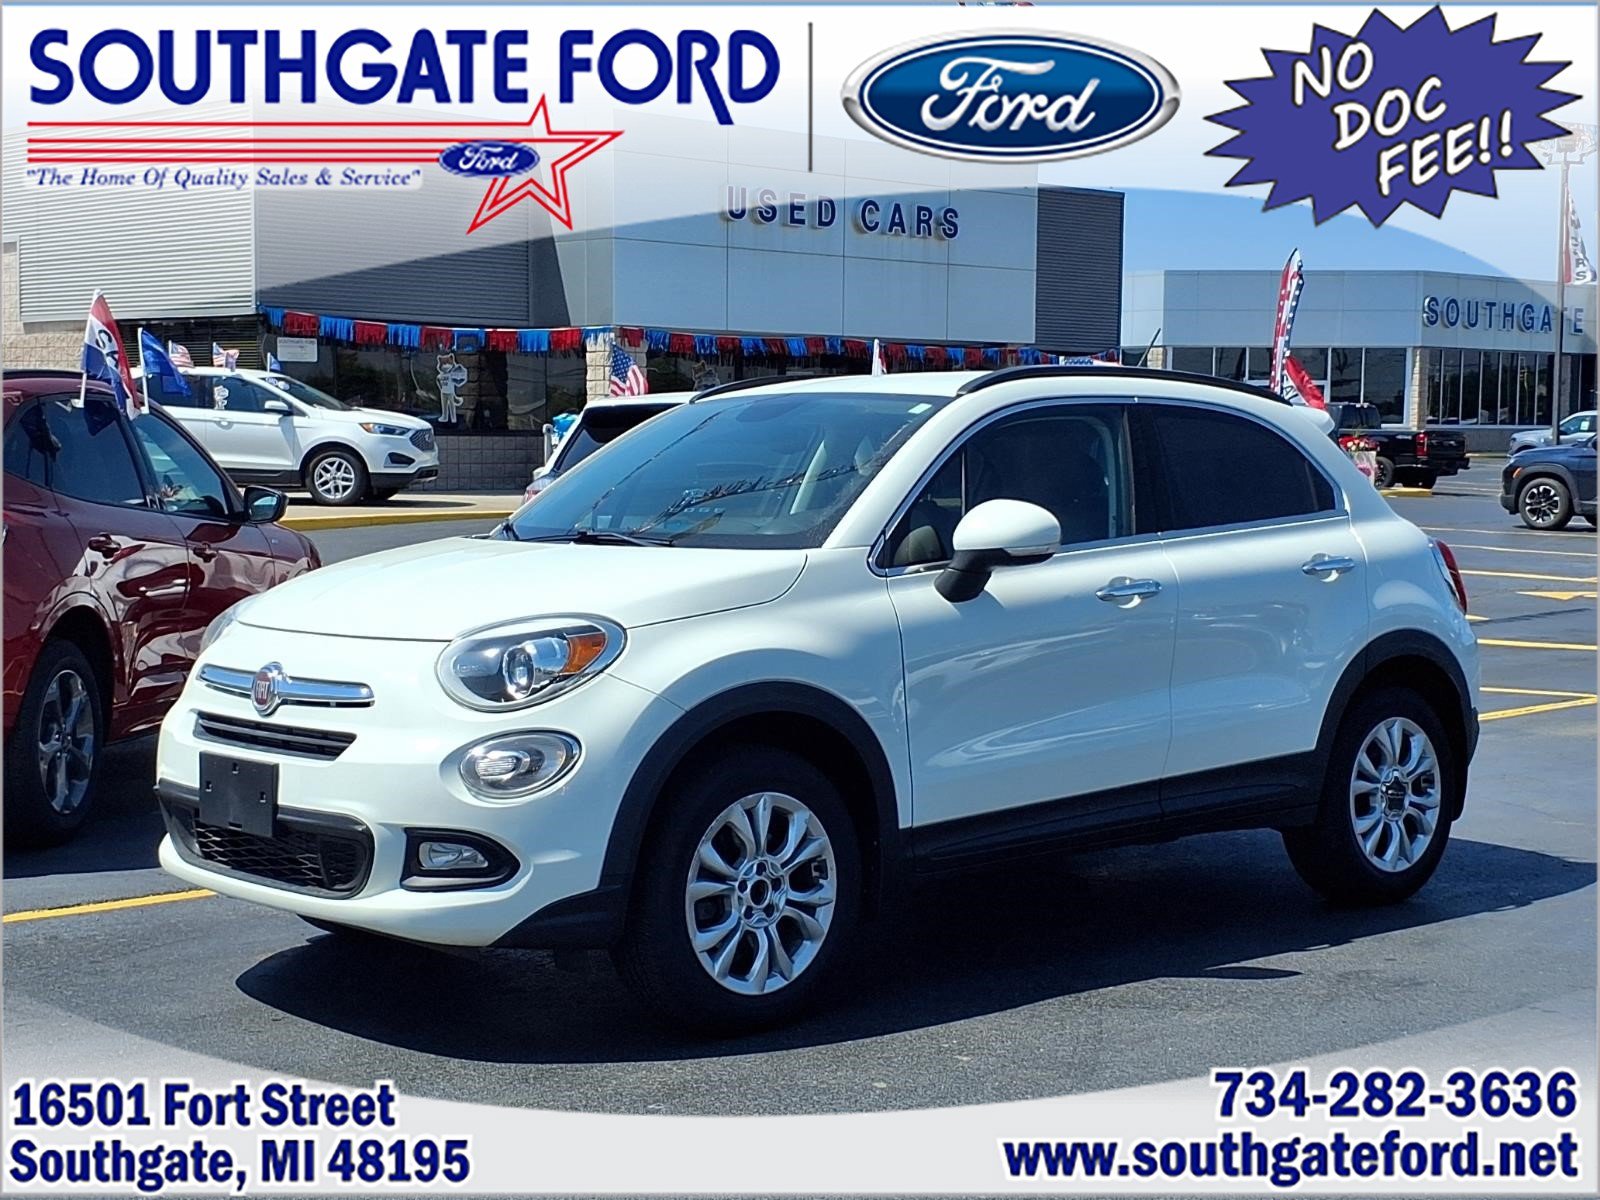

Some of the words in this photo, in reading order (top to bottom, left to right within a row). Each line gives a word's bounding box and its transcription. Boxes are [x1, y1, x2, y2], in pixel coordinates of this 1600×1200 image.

[727, 185, 837, 228] USED
[860, 199, 960, 240] CARS
[1424, 296, 1584, 335] SOUTHGAE
